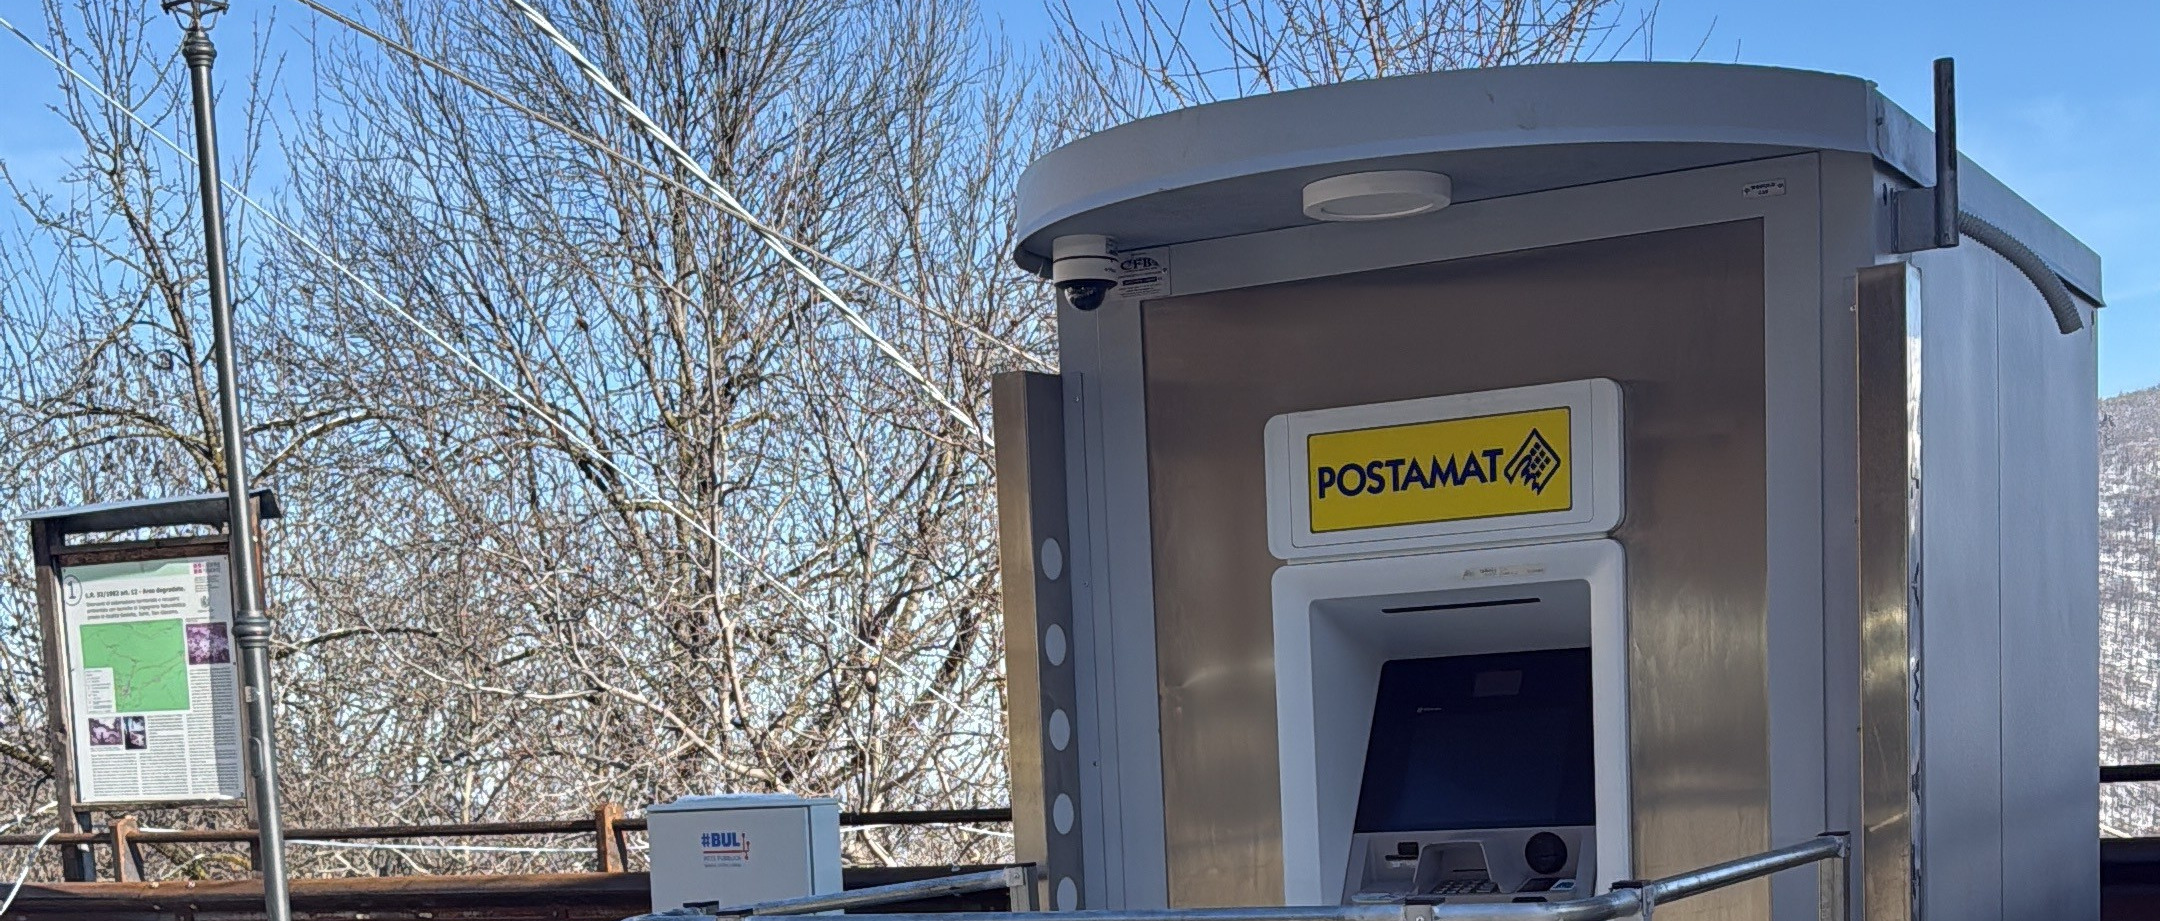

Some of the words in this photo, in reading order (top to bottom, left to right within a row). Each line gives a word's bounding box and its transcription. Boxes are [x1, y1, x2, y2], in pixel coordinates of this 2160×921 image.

[1318, 448, 1504, 499] POSTAMAT
[68, 580, 76, 599] 1
[701, 832, 741, 847] #BUL
